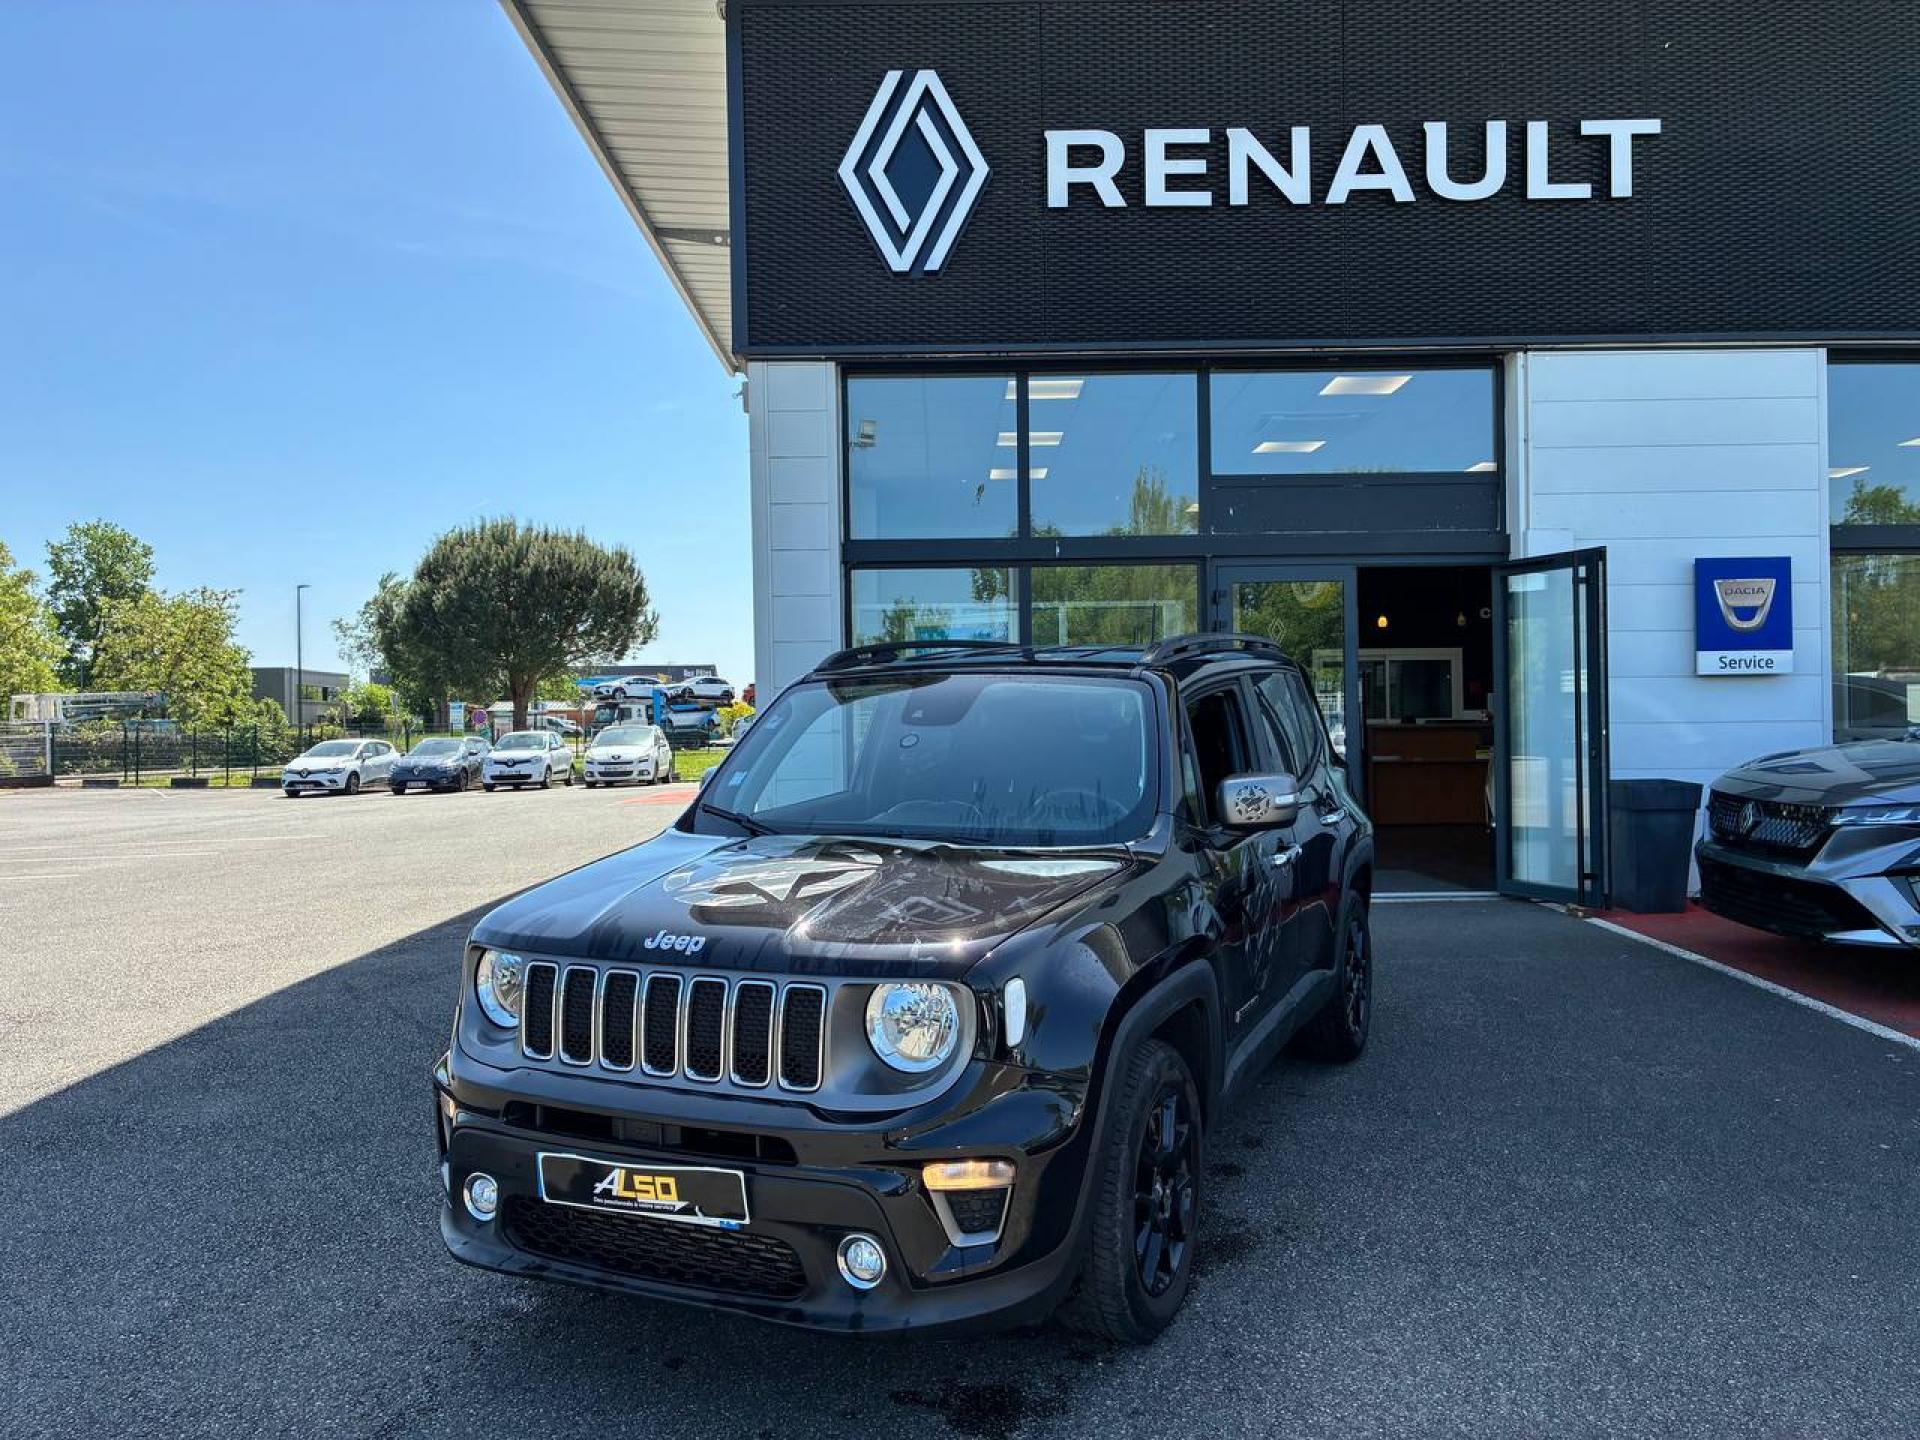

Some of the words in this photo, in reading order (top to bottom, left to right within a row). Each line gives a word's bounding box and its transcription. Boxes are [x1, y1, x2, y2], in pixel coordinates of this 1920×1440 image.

[1043, 118, 1662, 208] RENAULT
[1724, 586, 1765, 597] DACIA
[1718, 655, 1774, 670] Service
[644, 929, 706, 956] Jeep
